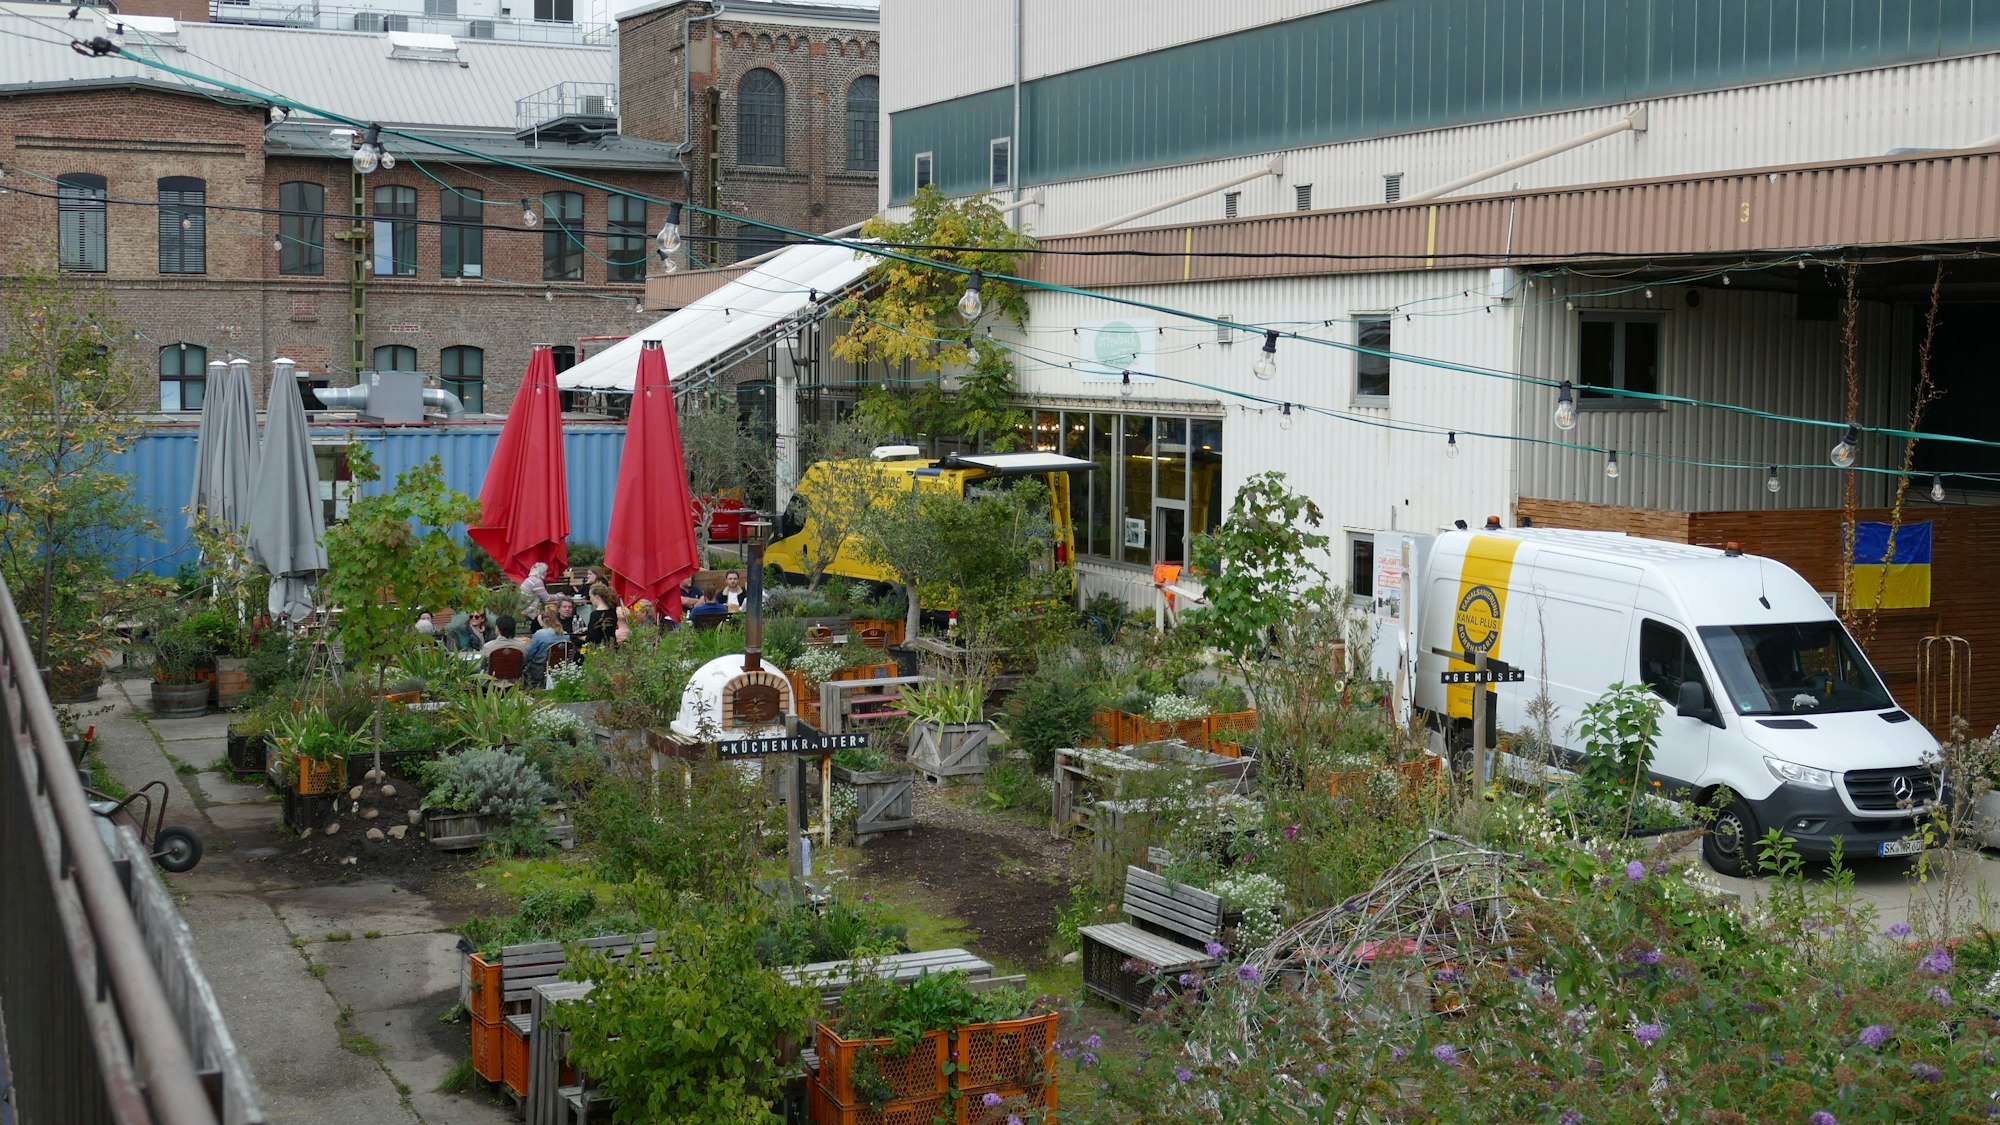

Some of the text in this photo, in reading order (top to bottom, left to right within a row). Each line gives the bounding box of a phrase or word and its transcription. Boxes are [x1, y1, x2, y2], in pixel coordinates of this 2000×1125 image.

[1740, 201, 1750, 223] 3
[1461, 588, 1499, 617] KANALSANIERUNG
[1456, 612, 1497, 629] KANAL PLUS
[1458, 626, 1496, 652] ROHRHAVARIE
[1884, 843, 1895, 853] SK
